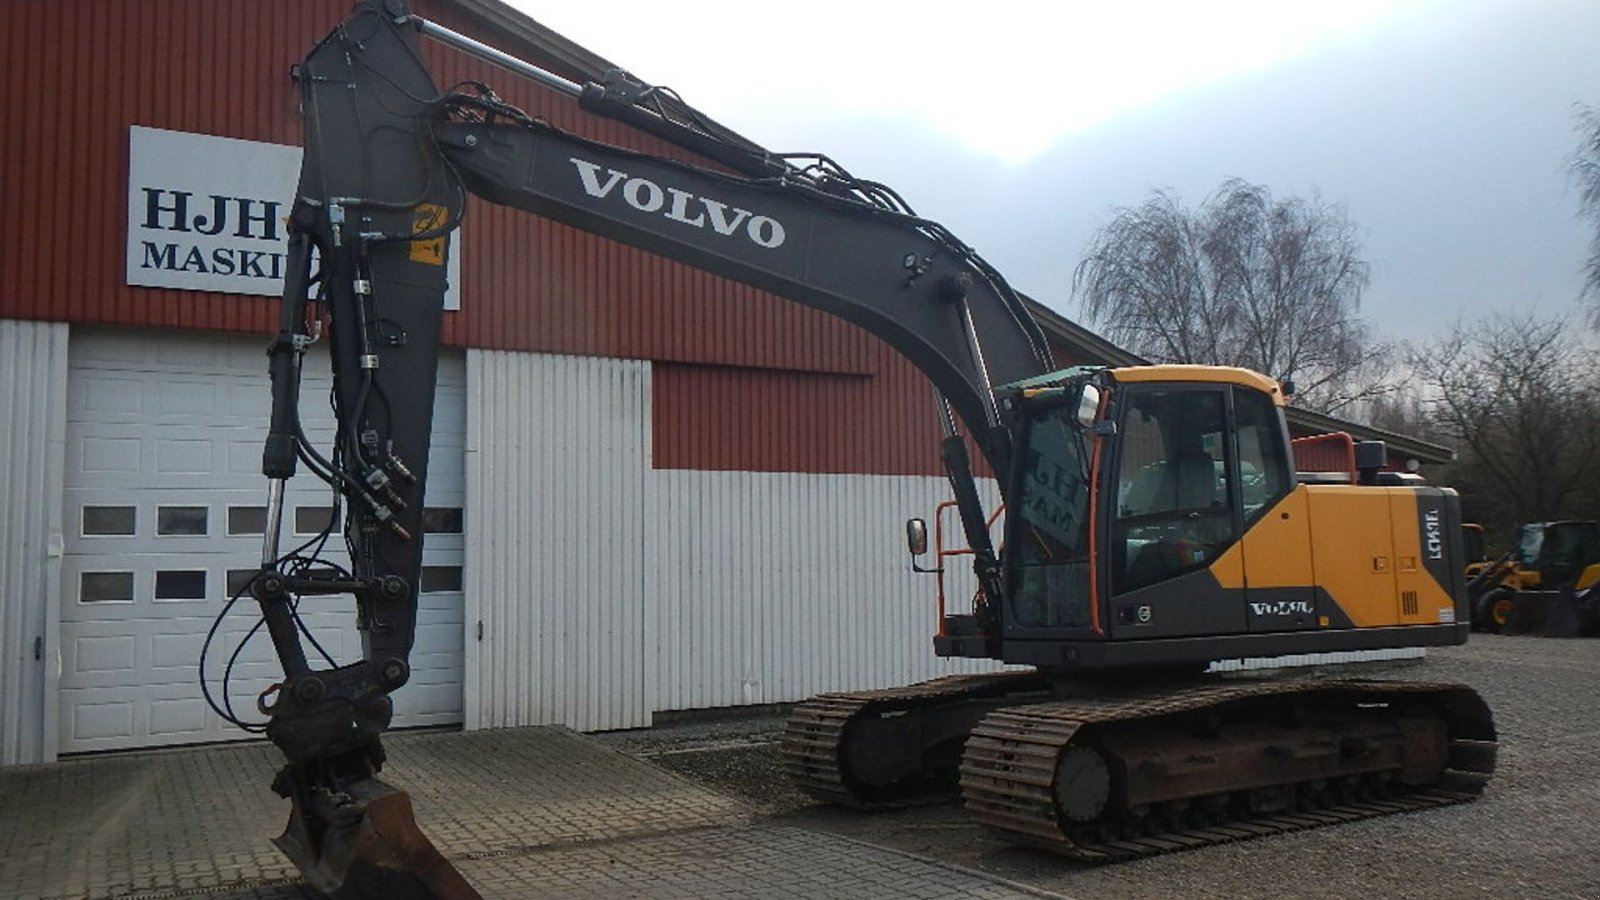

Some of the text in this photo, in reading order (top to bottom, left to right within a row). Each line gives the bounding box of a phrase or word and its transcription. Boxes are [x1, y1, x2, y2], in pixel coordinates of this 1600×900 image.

[141, 187, 283, 241] HJH
[569, 157, 786, 249] VOLVO
[141, 240, 288, 280] MASKI
